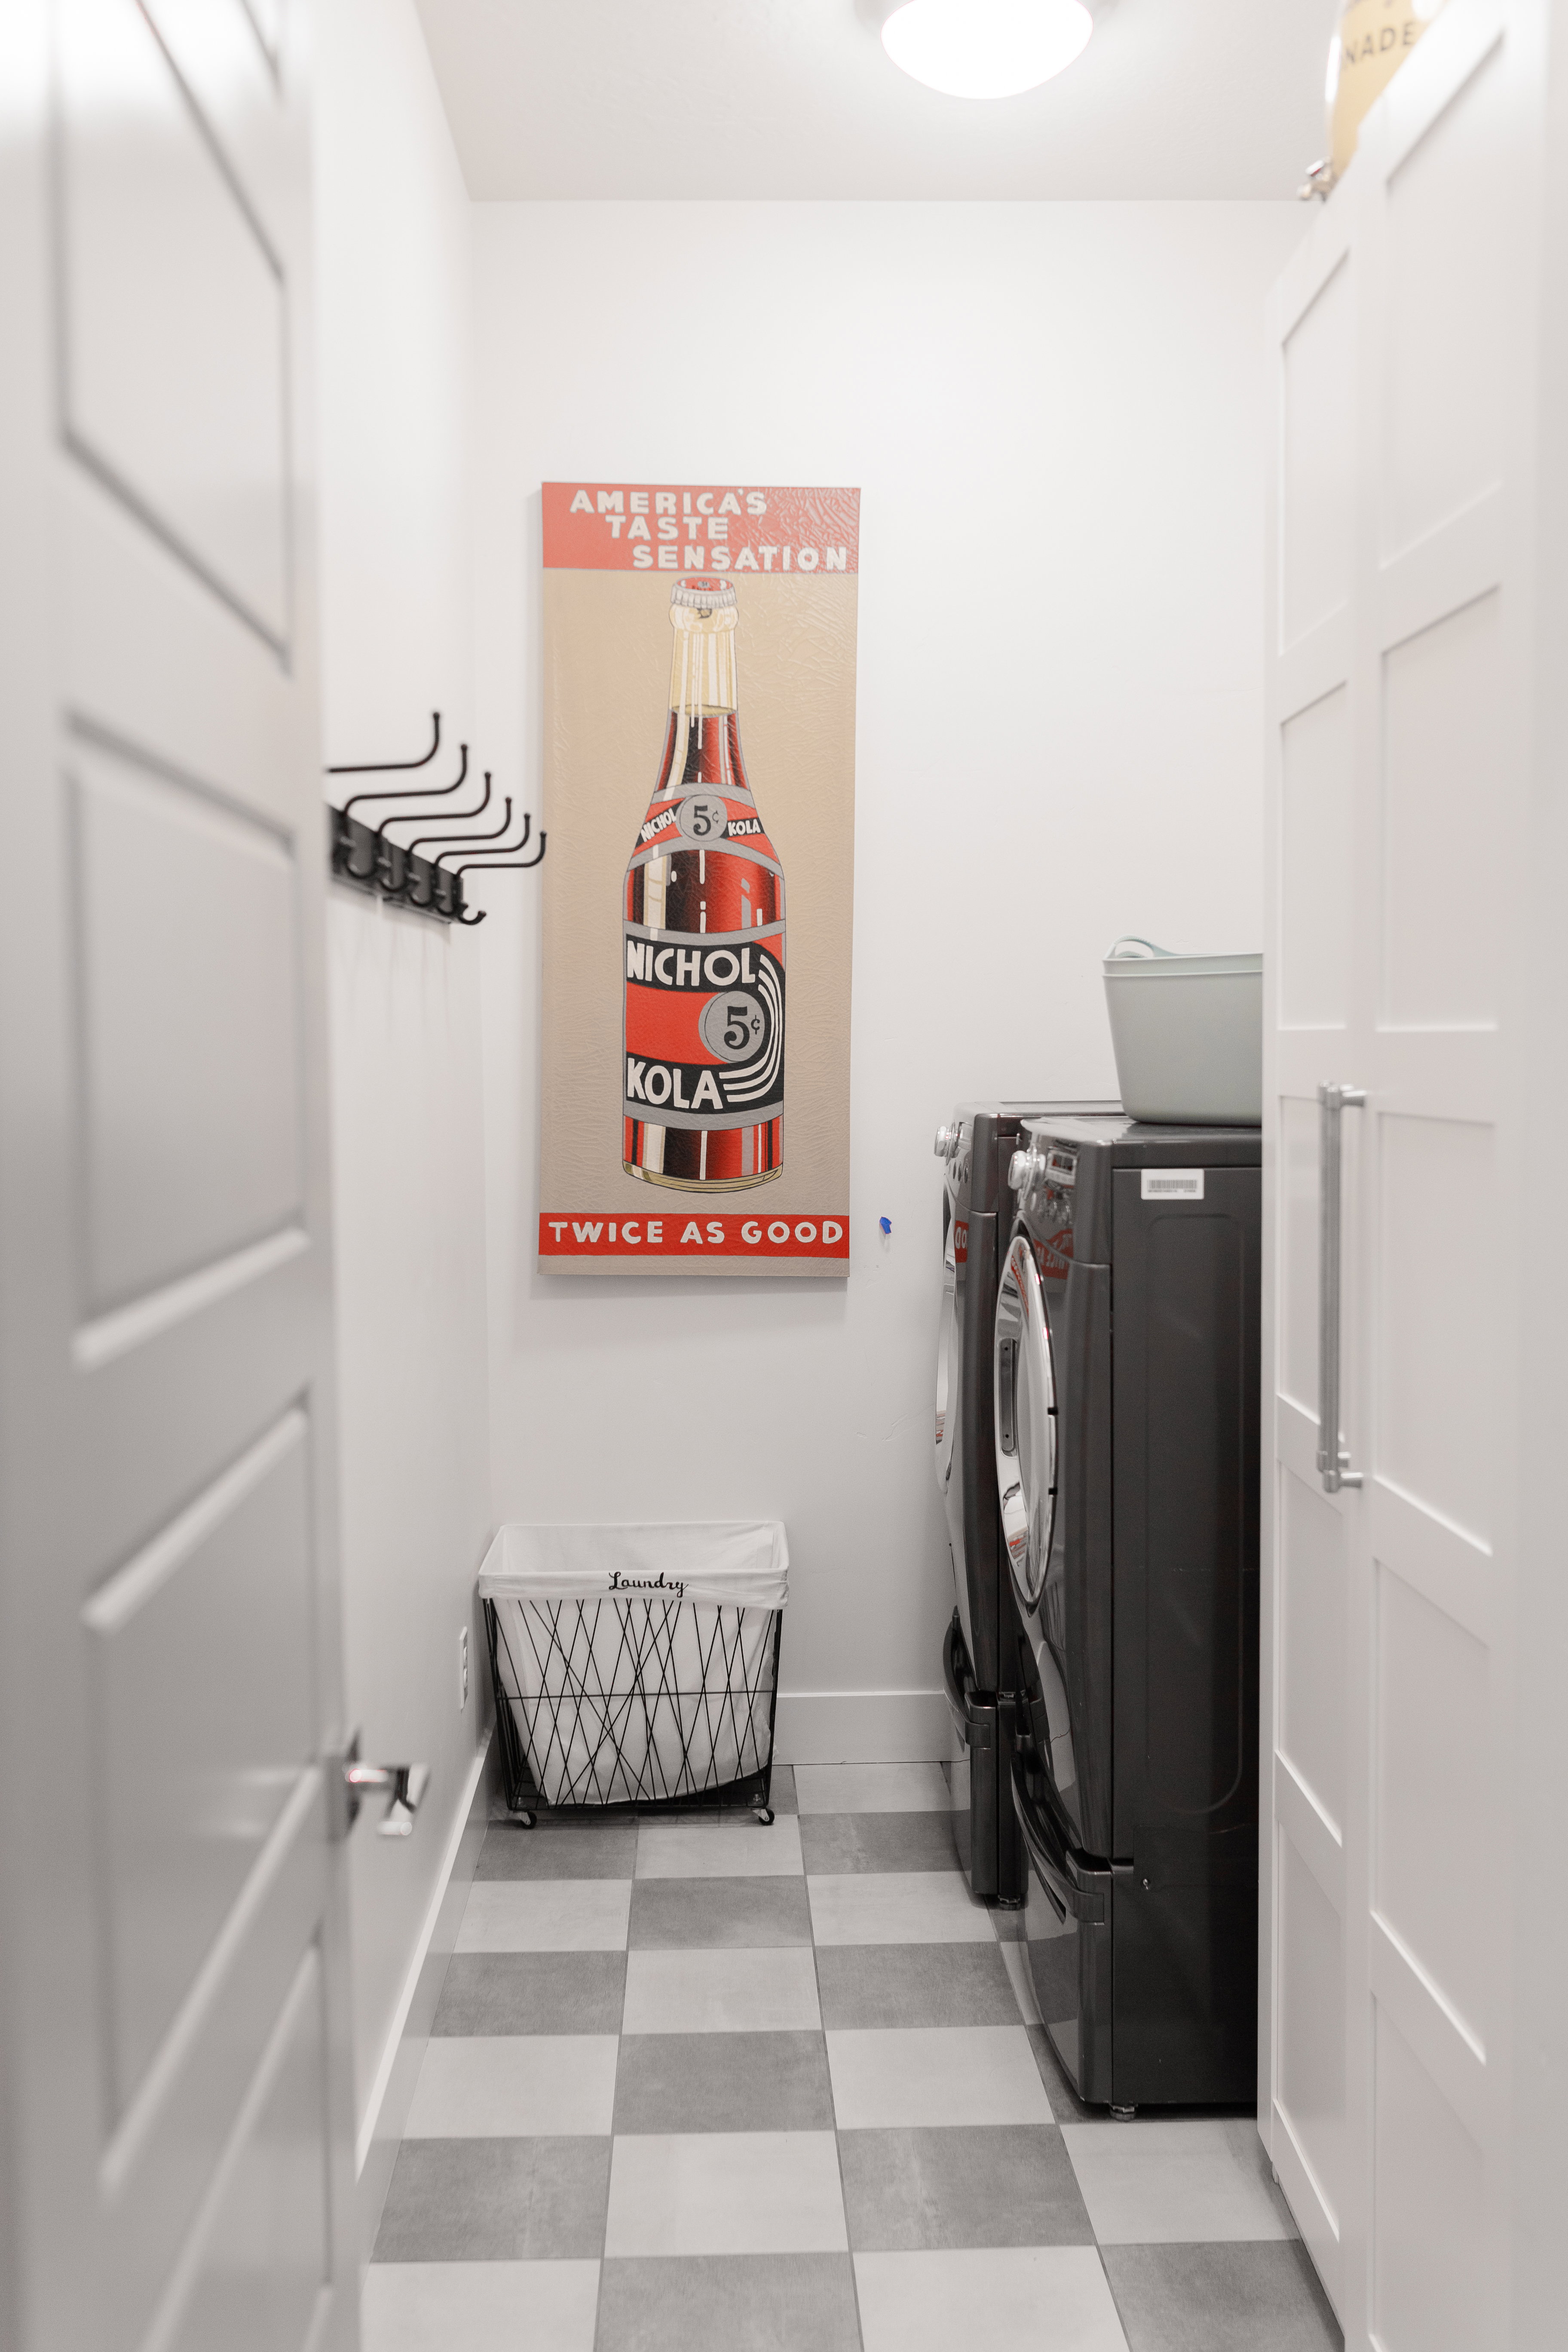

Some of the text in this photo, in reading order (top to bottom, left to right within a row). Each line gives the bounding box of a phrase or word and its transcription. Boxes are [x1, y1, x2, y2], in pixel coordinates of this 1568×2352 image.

[570, 489, 767, 516] AMERICA'S
[606, 515, 728, 540] TASTE
[633, 545, 847, 571] SENSATION
[640, 808, 677, 842] NICHOL
[728, 819, 761, 836] KOLA
[627, 940, 756, 986] NICHOL
[627, 1058, 723, 1109] KOLA
[548, 1221, 843, 1244] TWICE AS GOOD
[609, 1571, 689, 1598] Laundry
